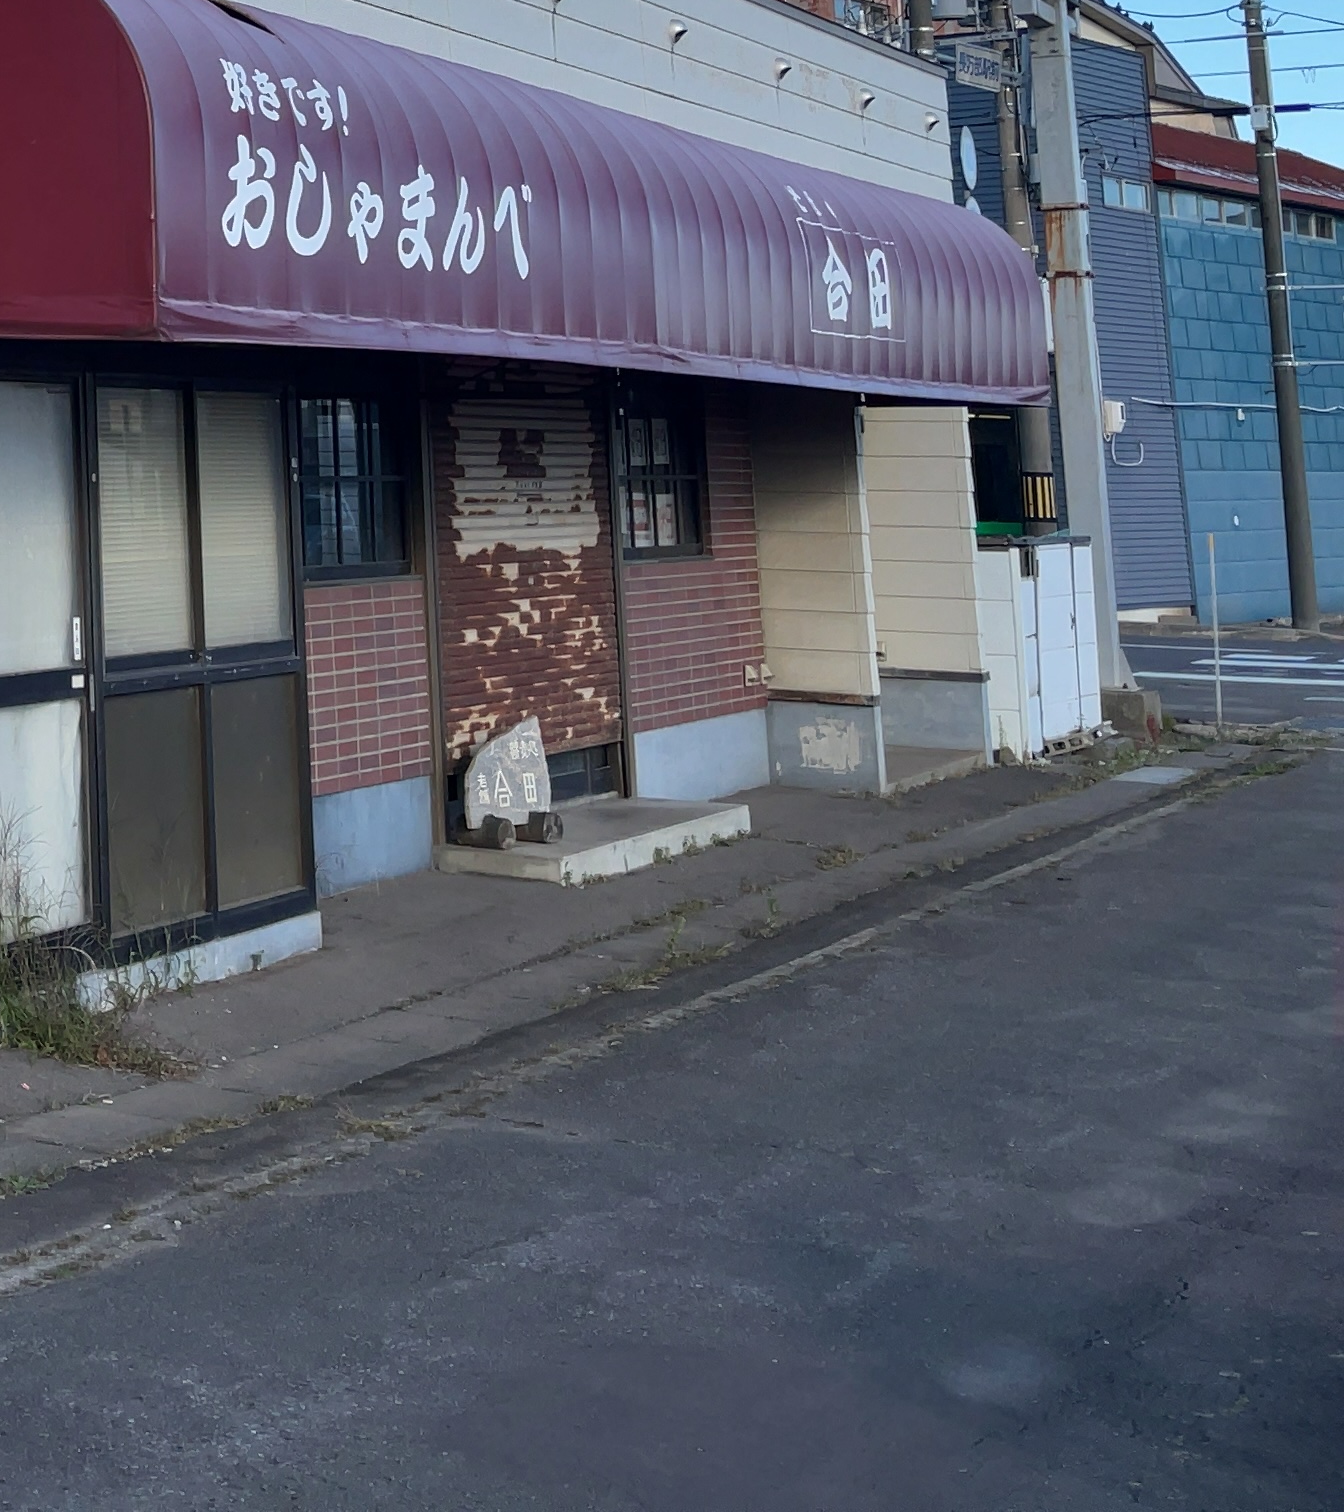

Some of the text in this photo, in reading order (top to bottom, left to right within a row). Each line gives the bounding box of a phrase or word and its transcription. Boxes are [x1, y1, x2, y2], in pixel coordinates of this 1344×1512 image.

[221, 135, 533, 281] おしゃまんべ
